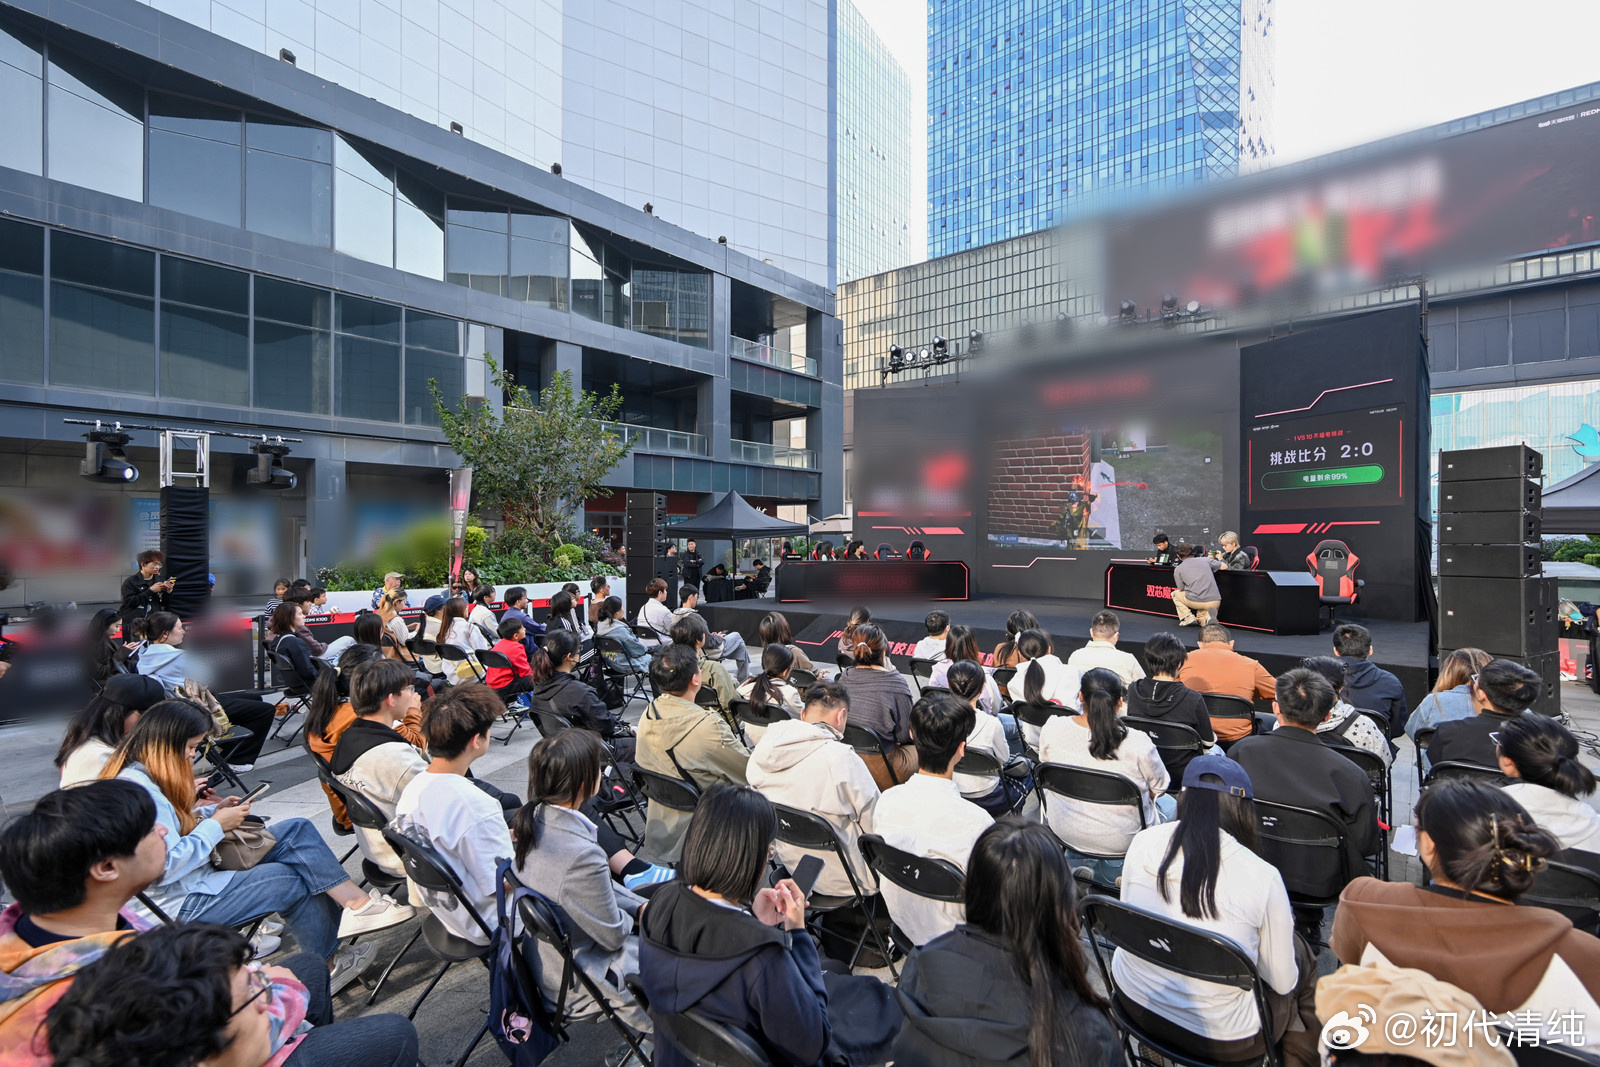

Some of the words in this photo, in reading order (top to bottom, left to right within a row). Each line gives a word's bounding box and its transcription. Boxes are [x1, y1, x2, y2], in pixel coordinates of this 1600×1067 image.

[1269, 446, 1327, 466] 挑战比分
[1340, 442, 1374, 459] 2:0
[1302, 472, 1348, 482] 电量剩余99%
[1146, 584, 1179, 600] 双芯魔
